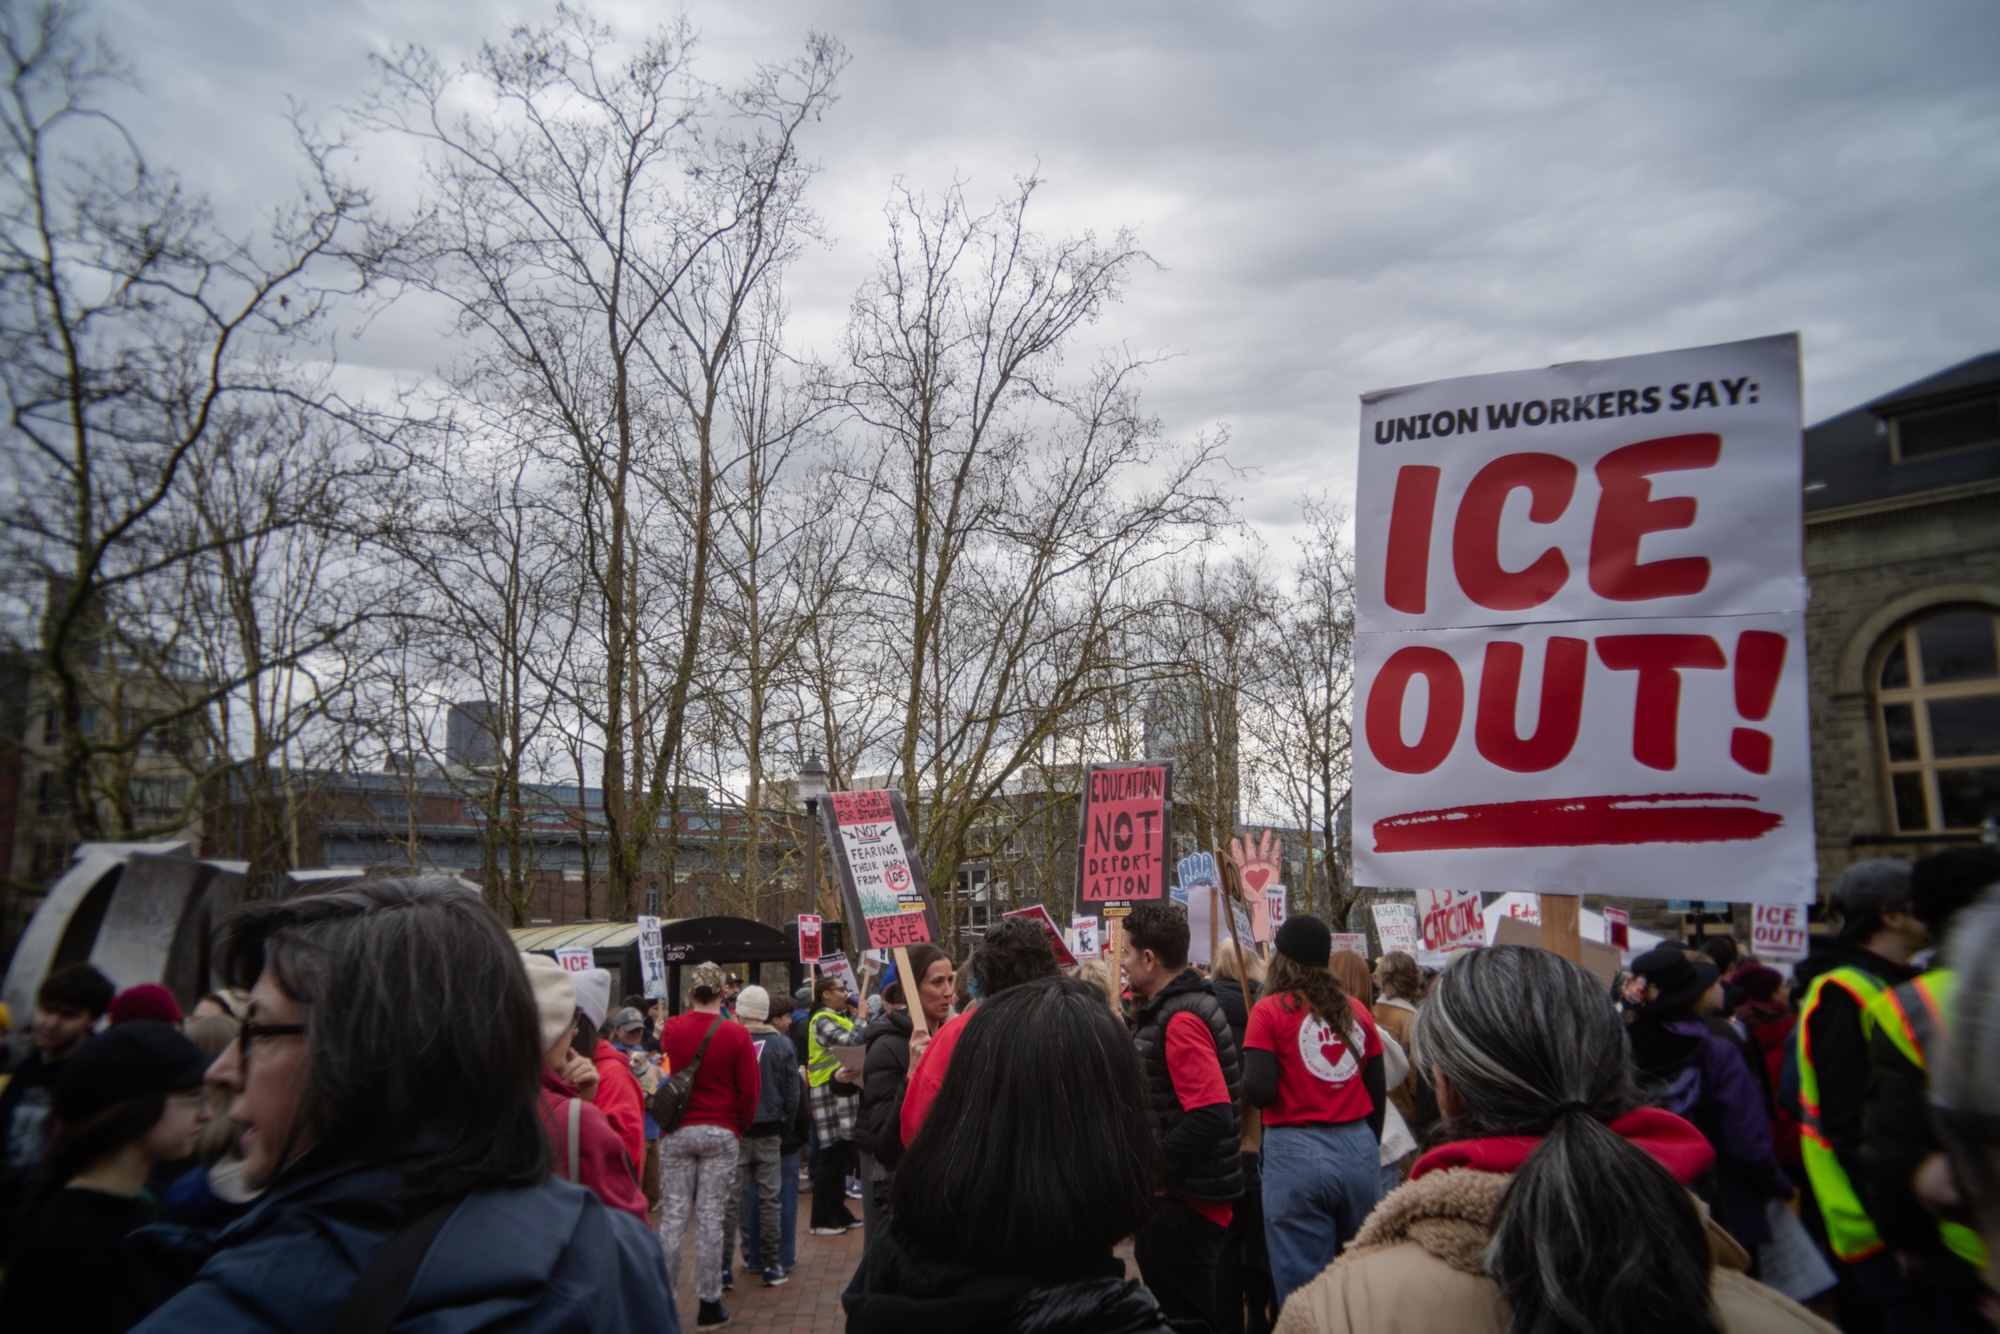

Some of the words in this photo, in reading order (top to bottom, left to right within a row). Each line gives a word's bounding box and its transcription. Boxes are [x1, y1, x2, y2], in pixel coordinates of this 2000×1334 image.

[1374, 407, 1478, 445] UNION
[1486, 385, 1662, 431] WORKERS
[1670, 377, 1760, 411] SAY:
[1384, 432, 1722, 615] ICE
[1365, 630, 1787, 775] OUT!
[1091, 770, 1162, 803] EDUCATION
[836, 800, 850, 809] TO
[837, 810, 856, 822] FOR
[854, 824, 878, 838] NOT
[1094, 810, 1158, 854] NOT
[850, 843, 898, 860] FEARING
[852, 861, 879, 874] THEIR
[883, 858, 908, 869] HARM
[1089, 853, 1162, 876] DEPORT-
[857, 874, 882, 886] FROM
[1090, 873, 1150, 898] ATION
[1268, 897, 1283, 921] ICE
[1375, 906, 1402, 918] RIGHT
[1757, 905, 1798, 927] ICE
[868, 914, 896, 931] KEEP
[897, 912, 923, 925] THEM
[1423, 895, 1484, 951] CATCHING
[874, 925, 925, 945] SAFE.
[1755, 926, 1805, 945] OUT!
[562, 955, 589, 972] ICE
